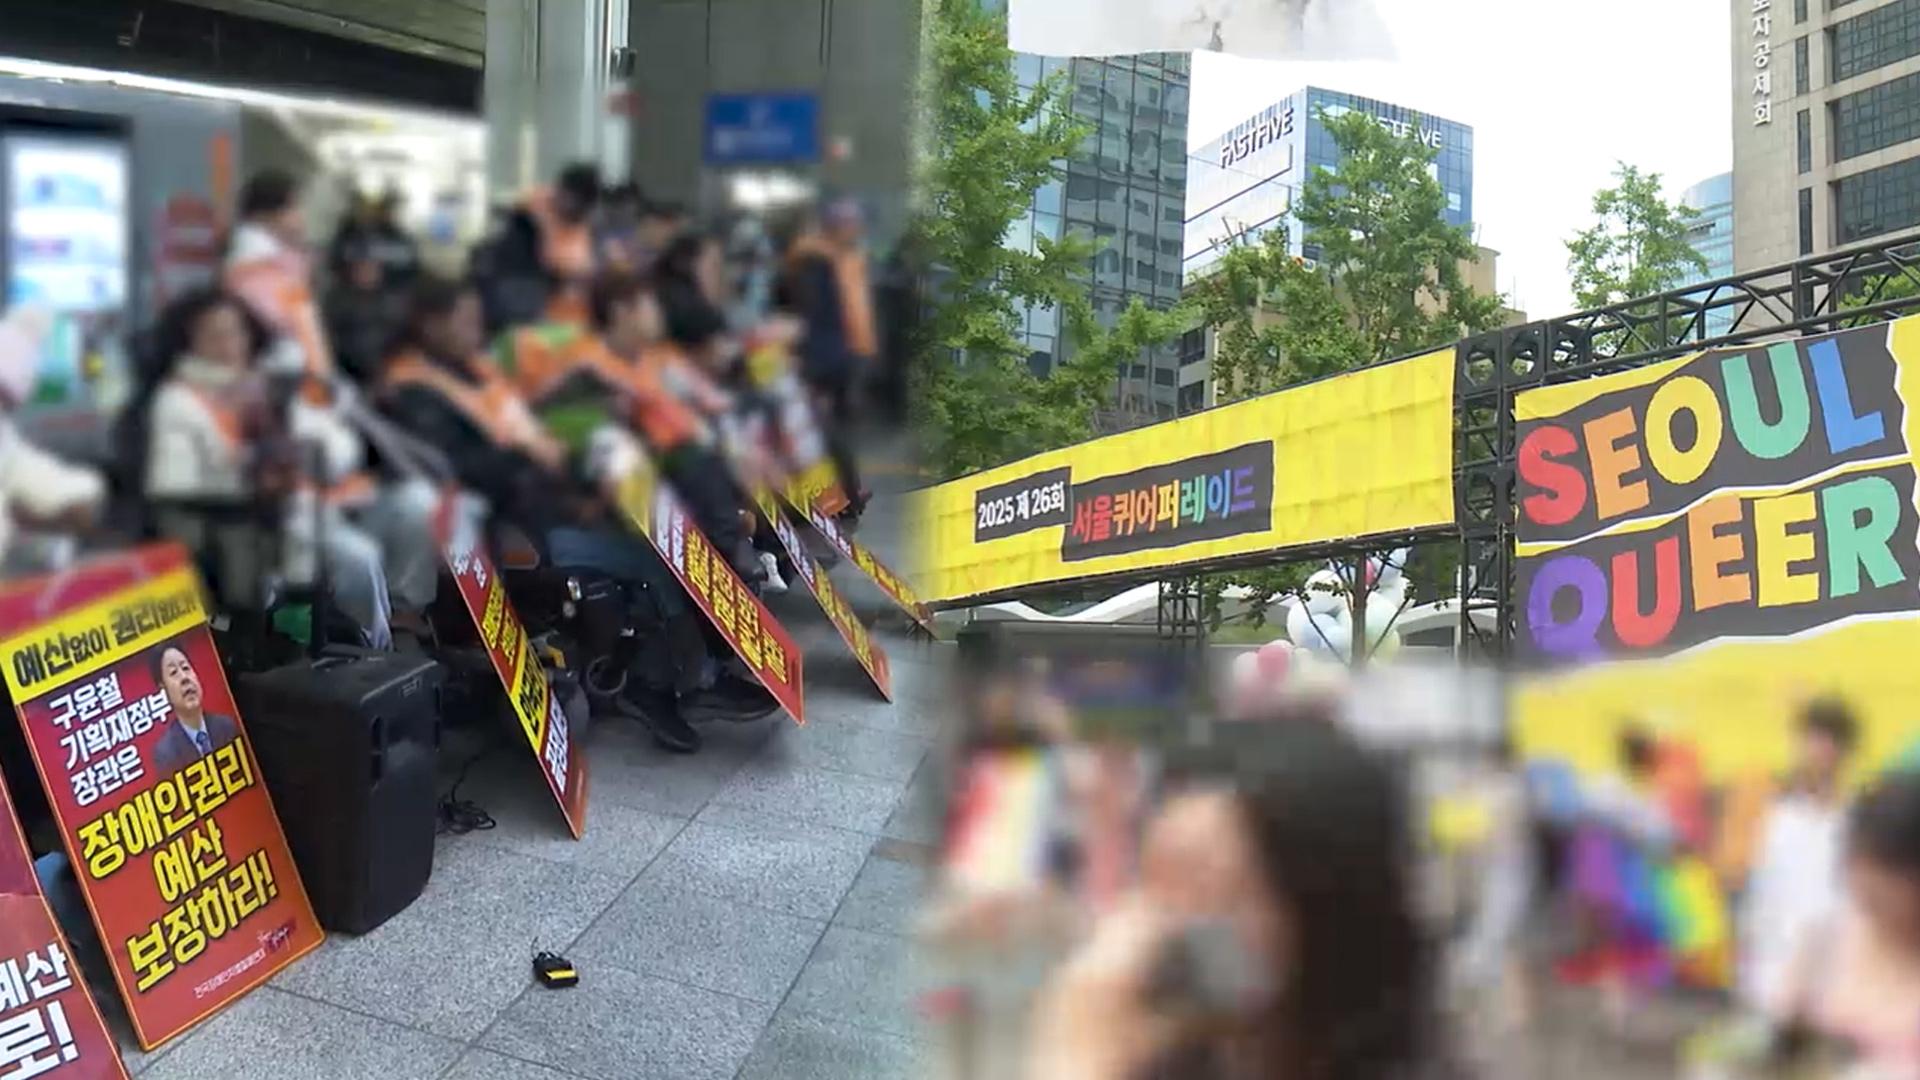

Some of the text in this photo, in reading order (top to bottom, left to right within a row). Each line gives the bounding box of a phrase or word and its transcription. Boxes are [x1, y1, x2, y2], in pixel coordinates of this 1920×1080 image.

[1220, 107, 1295, 169] FASTFIVE
[1518, 338, 1885, 526] SEOUL
[978, 496, 1015, 530] 2025
[1071, 465, 1255, 544] 서울퀴어퍼레이드
[1526, 475, 1907, 660] QUEER
[12, 624, 111, 688] 예산없이
[49, 671, 125, 730] 구윤철
[60, 688, 172, 770] 기획재정부
[70, 745, 145, 806] 장관은
[77, 736, 255, 879] 장애인권리
[153, 817, 229, 902] 예산
[126, 849, 279, 993] 보장하라!
[0, 1000, 80, 1080] 로!
